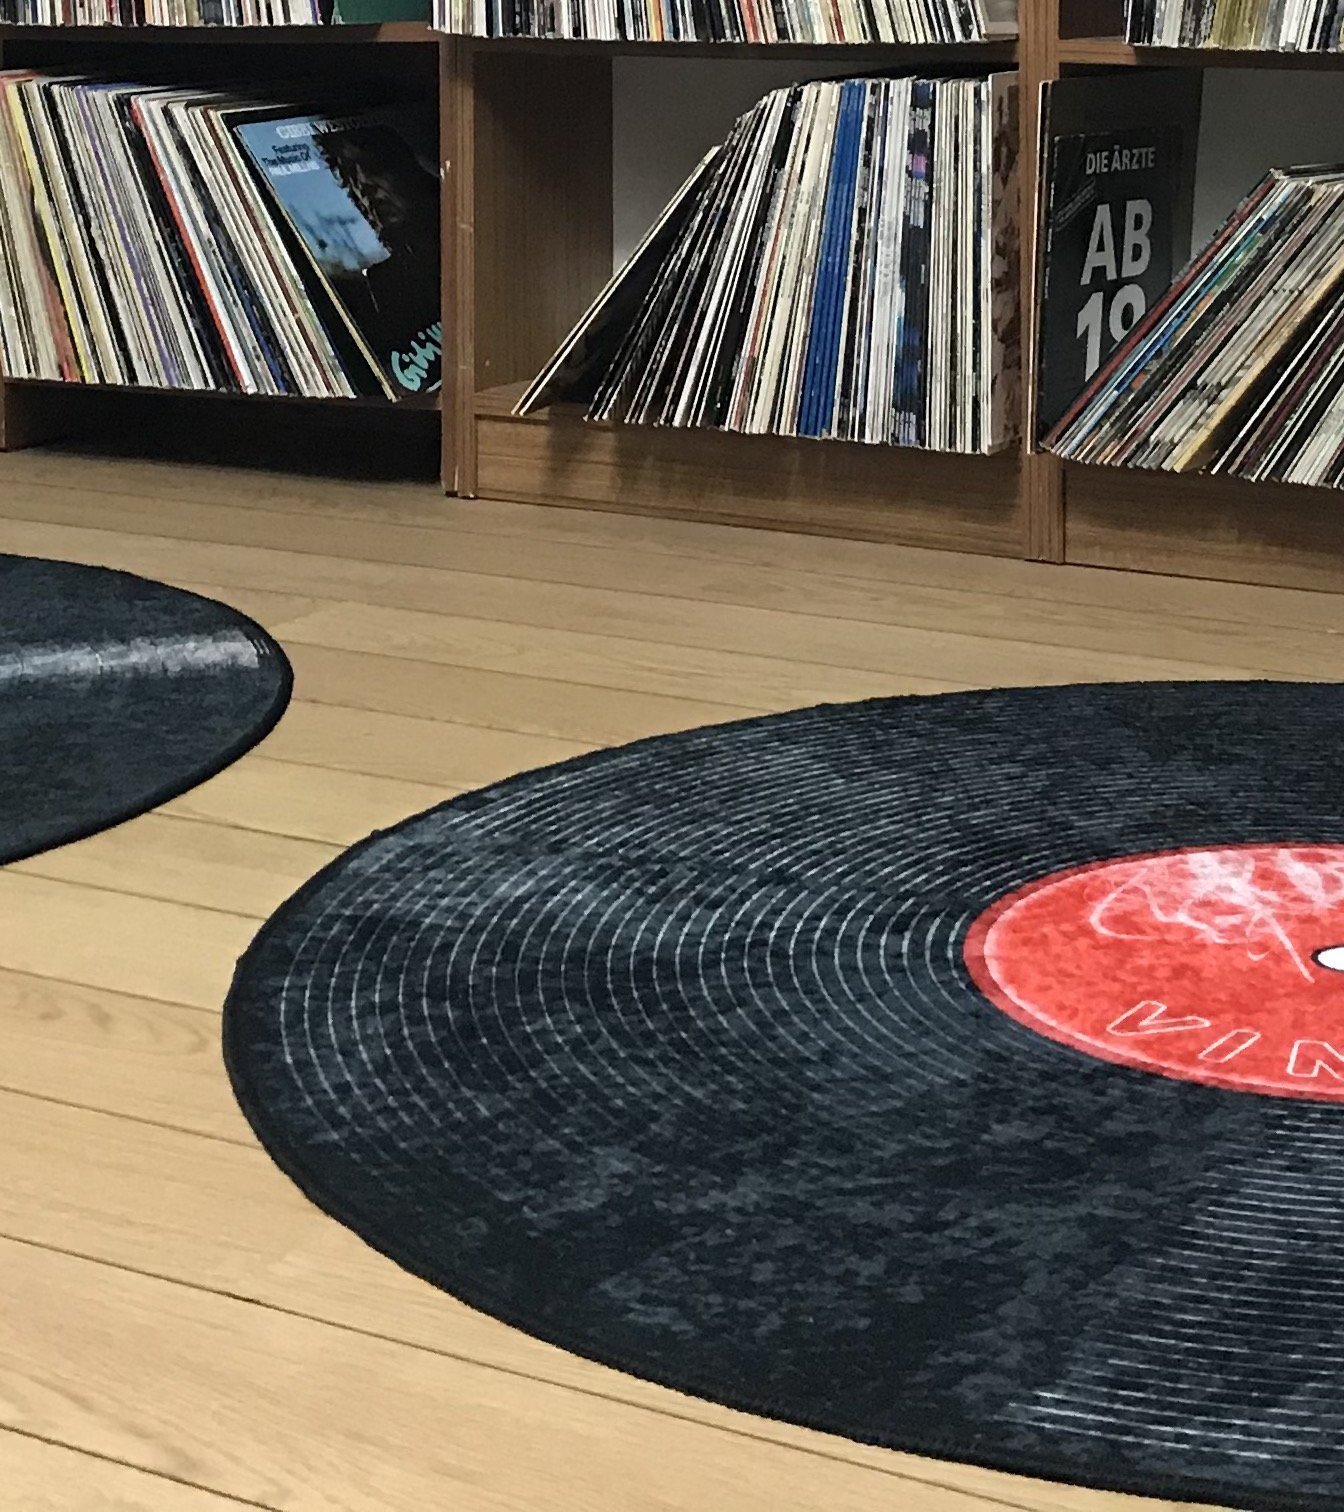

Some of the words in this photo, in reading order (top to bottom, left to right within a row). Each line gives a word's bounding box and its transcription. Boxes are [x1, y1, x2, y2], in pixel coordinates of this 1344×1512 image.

[1086, 151, 1109, 175] DIE
[1111, 144, 1156, 172] ÄRZTE
[1080, 198, 1153, 286] AB
